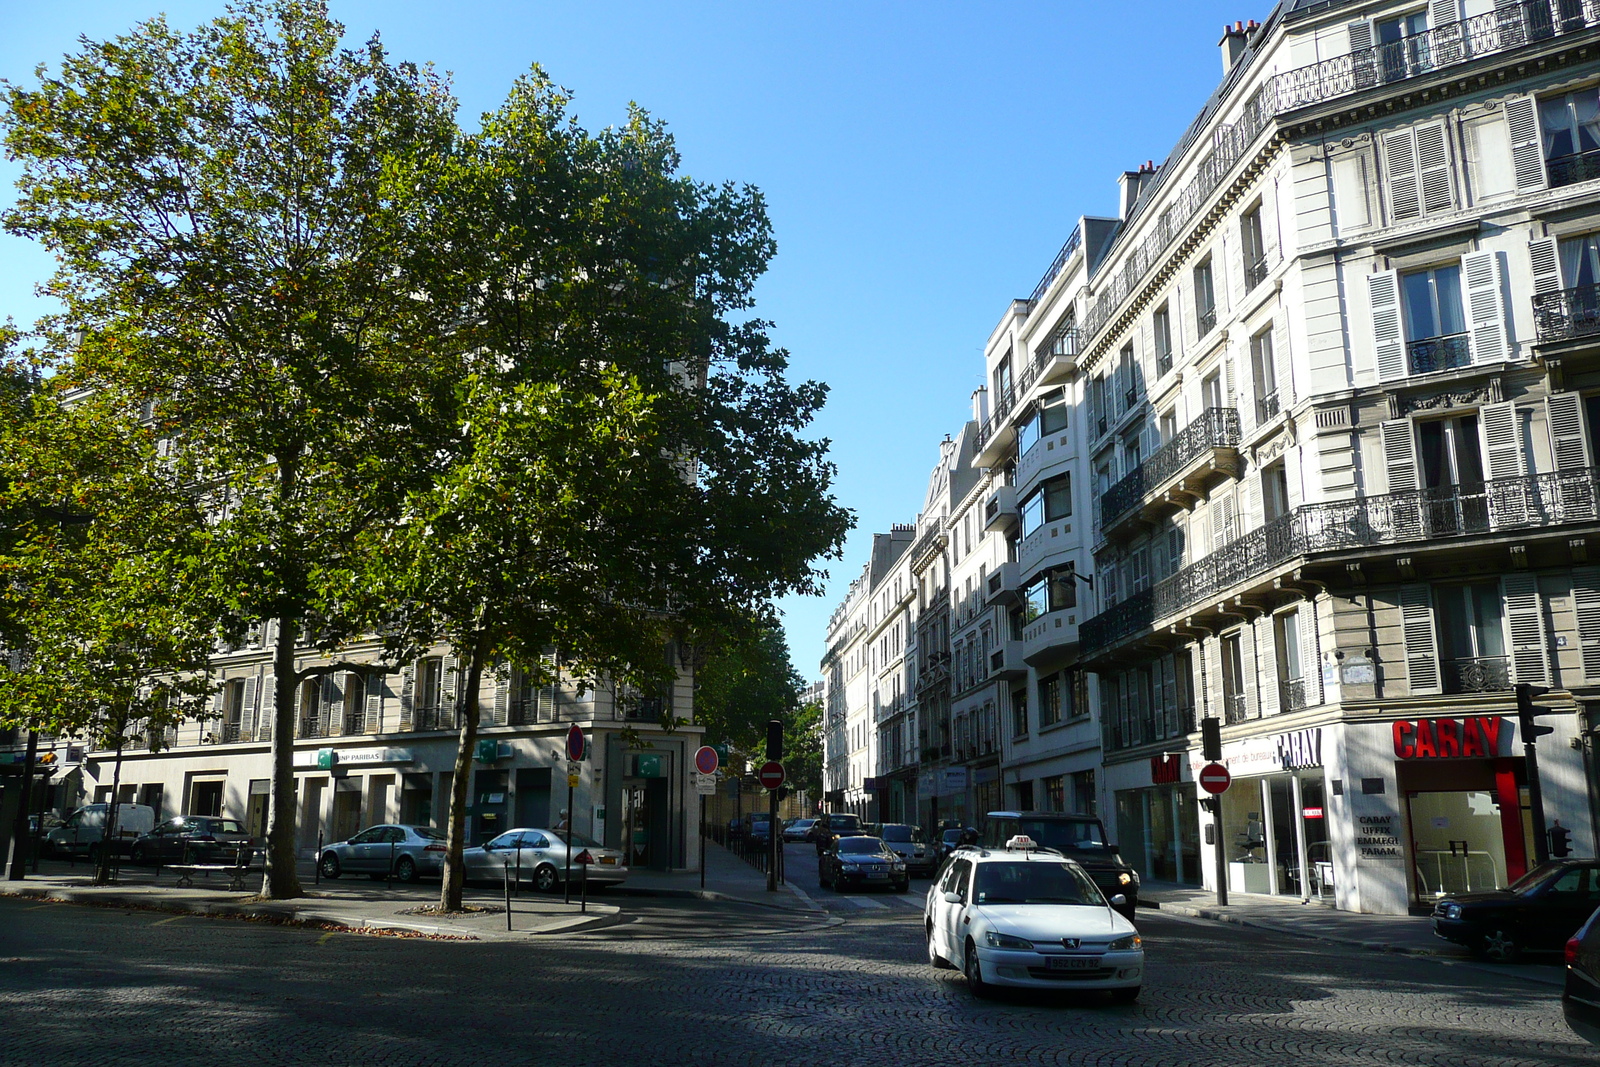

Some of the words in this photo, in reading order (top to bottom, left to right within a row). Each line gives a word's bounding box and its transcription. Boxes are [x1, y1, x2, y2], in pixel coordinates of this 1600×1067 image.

[1392, 716, 1500, 758] CARAY
[1275, 728, 1321, 769] CARAY
[351, 753, 379, 761] PARIBAS
[1359, 815, 1391, 824] CARAY
[1362, 826, 1391, 835] UFFIX
[1357, 837, 1399, 845] EMMEGI
[1361, 847, 1396, 856] FARAM
